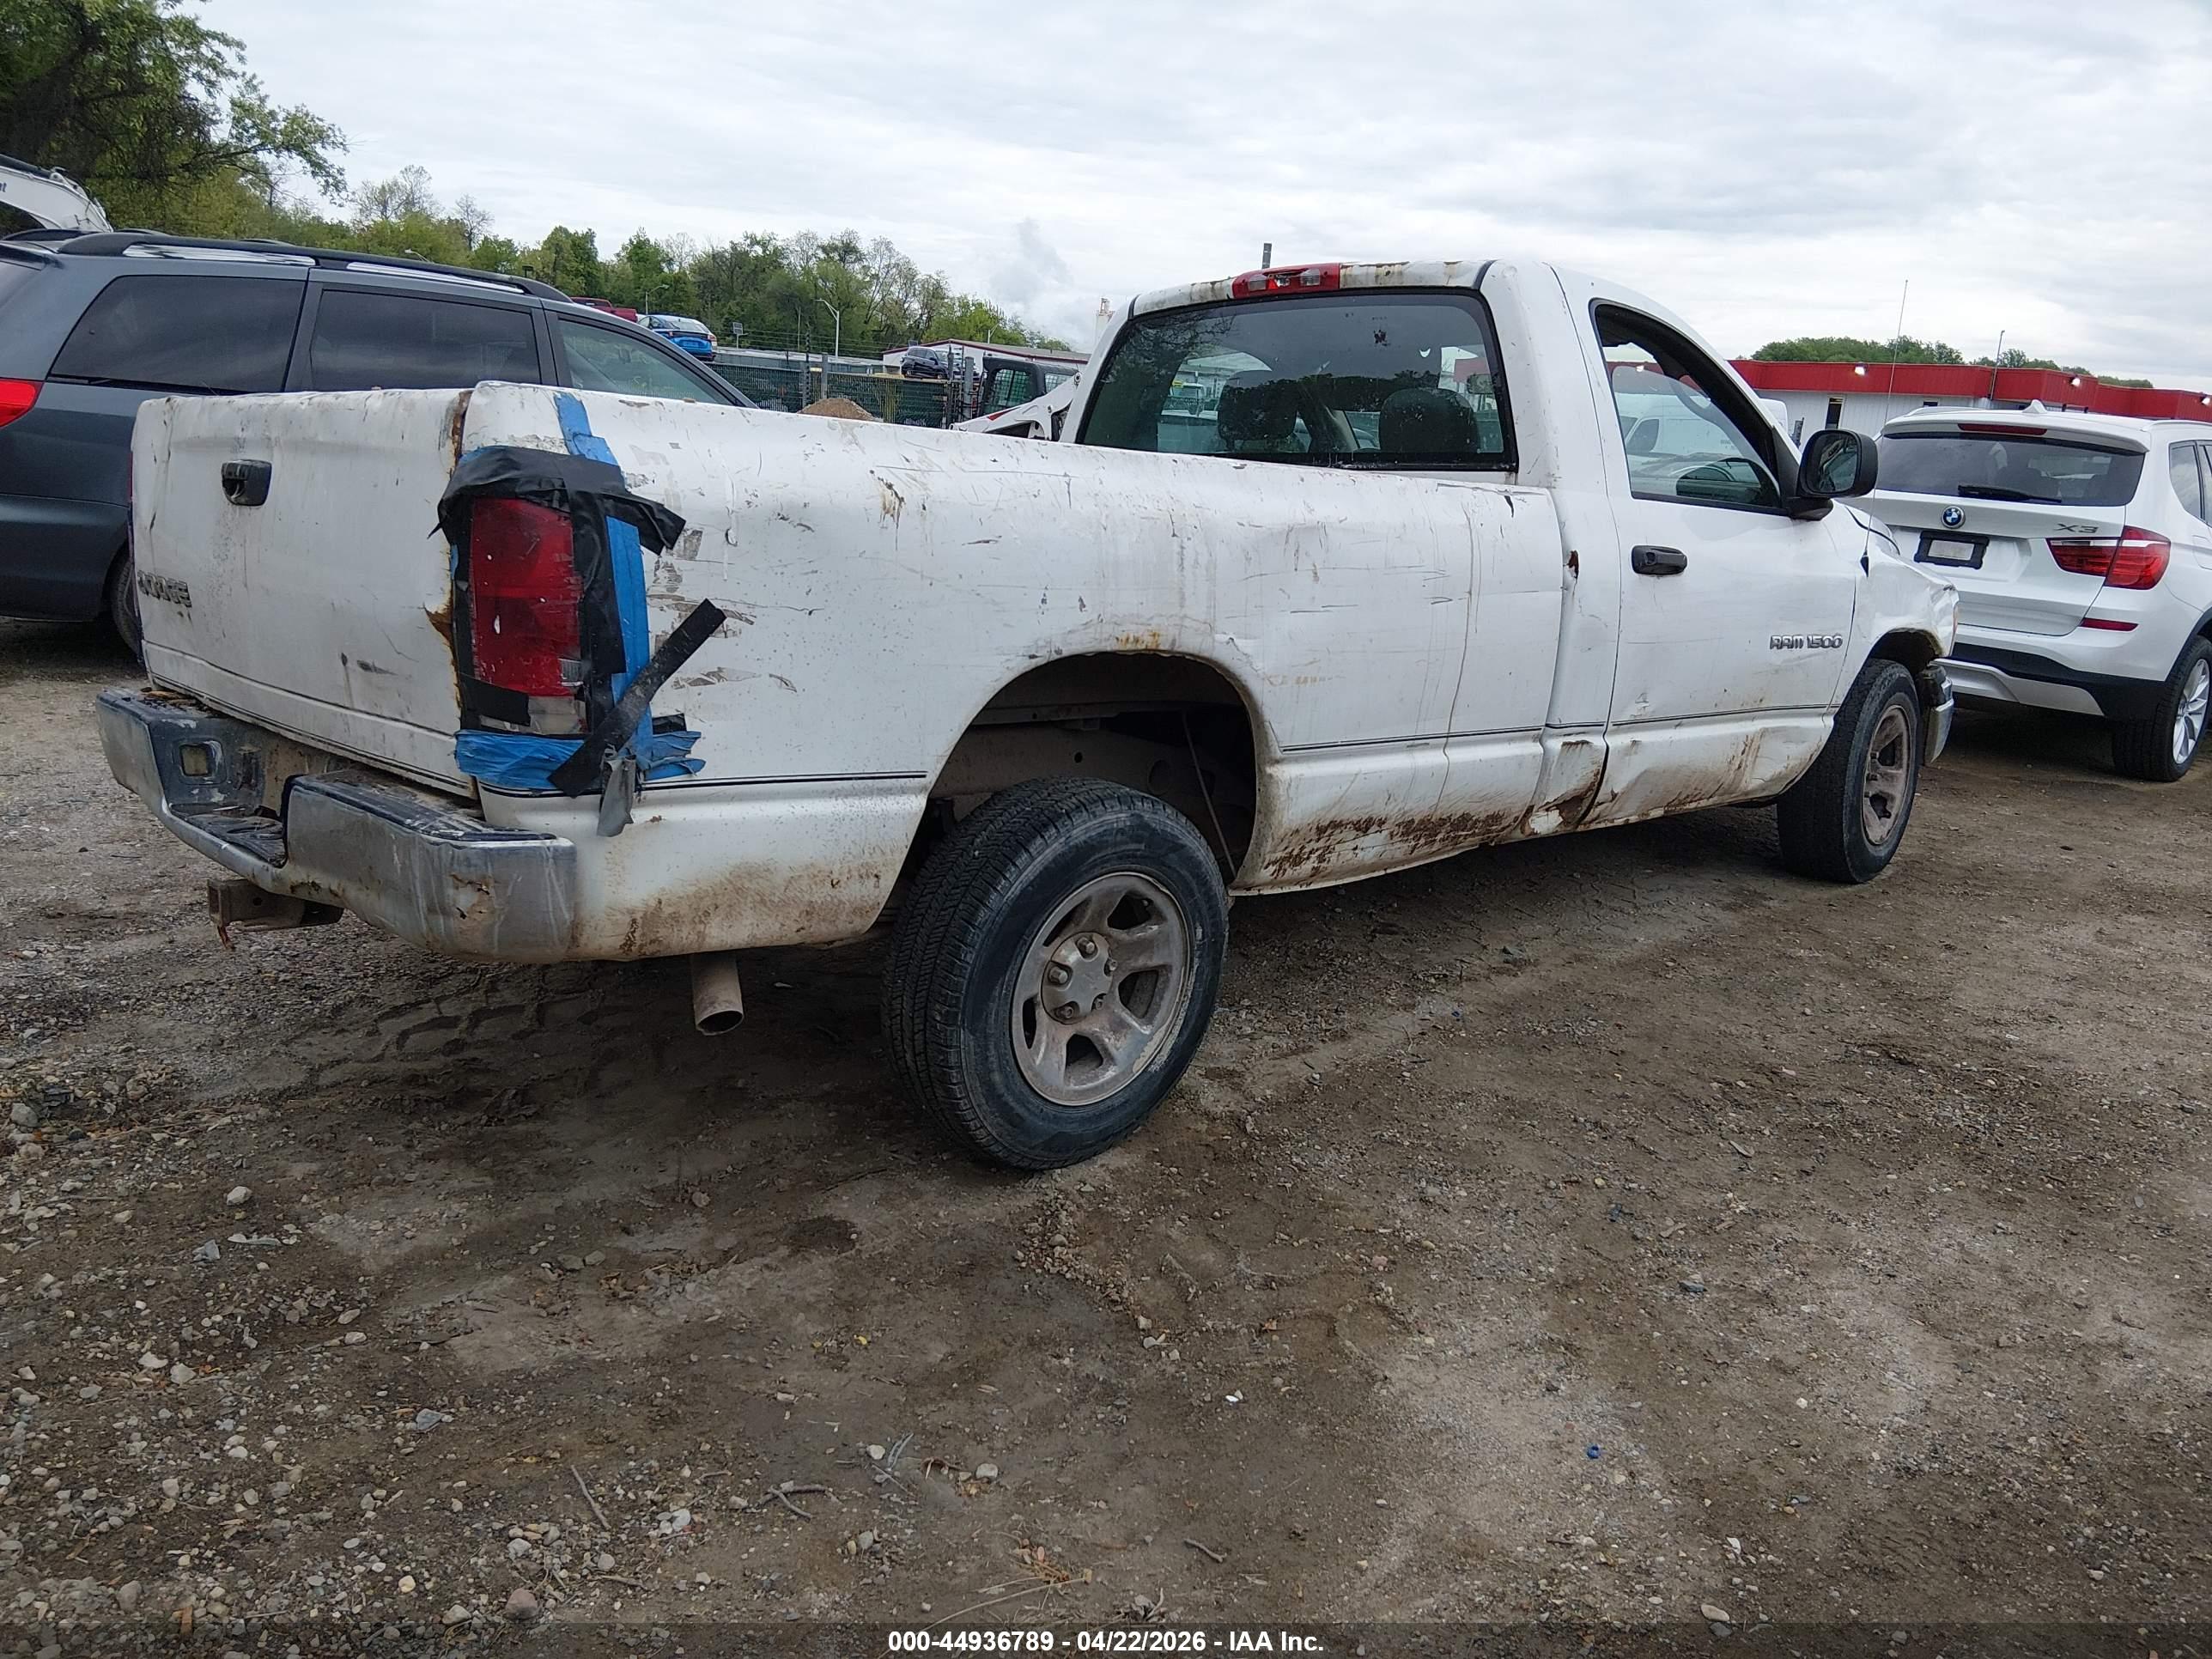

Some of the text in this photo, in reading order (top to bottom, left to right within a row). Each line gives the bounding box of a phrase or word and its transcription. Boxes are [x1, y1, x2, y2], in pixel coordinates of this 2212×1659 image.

[2054, 522, 2100, 534] X3
[1769, 634, 1844, 650] RAM 1500
